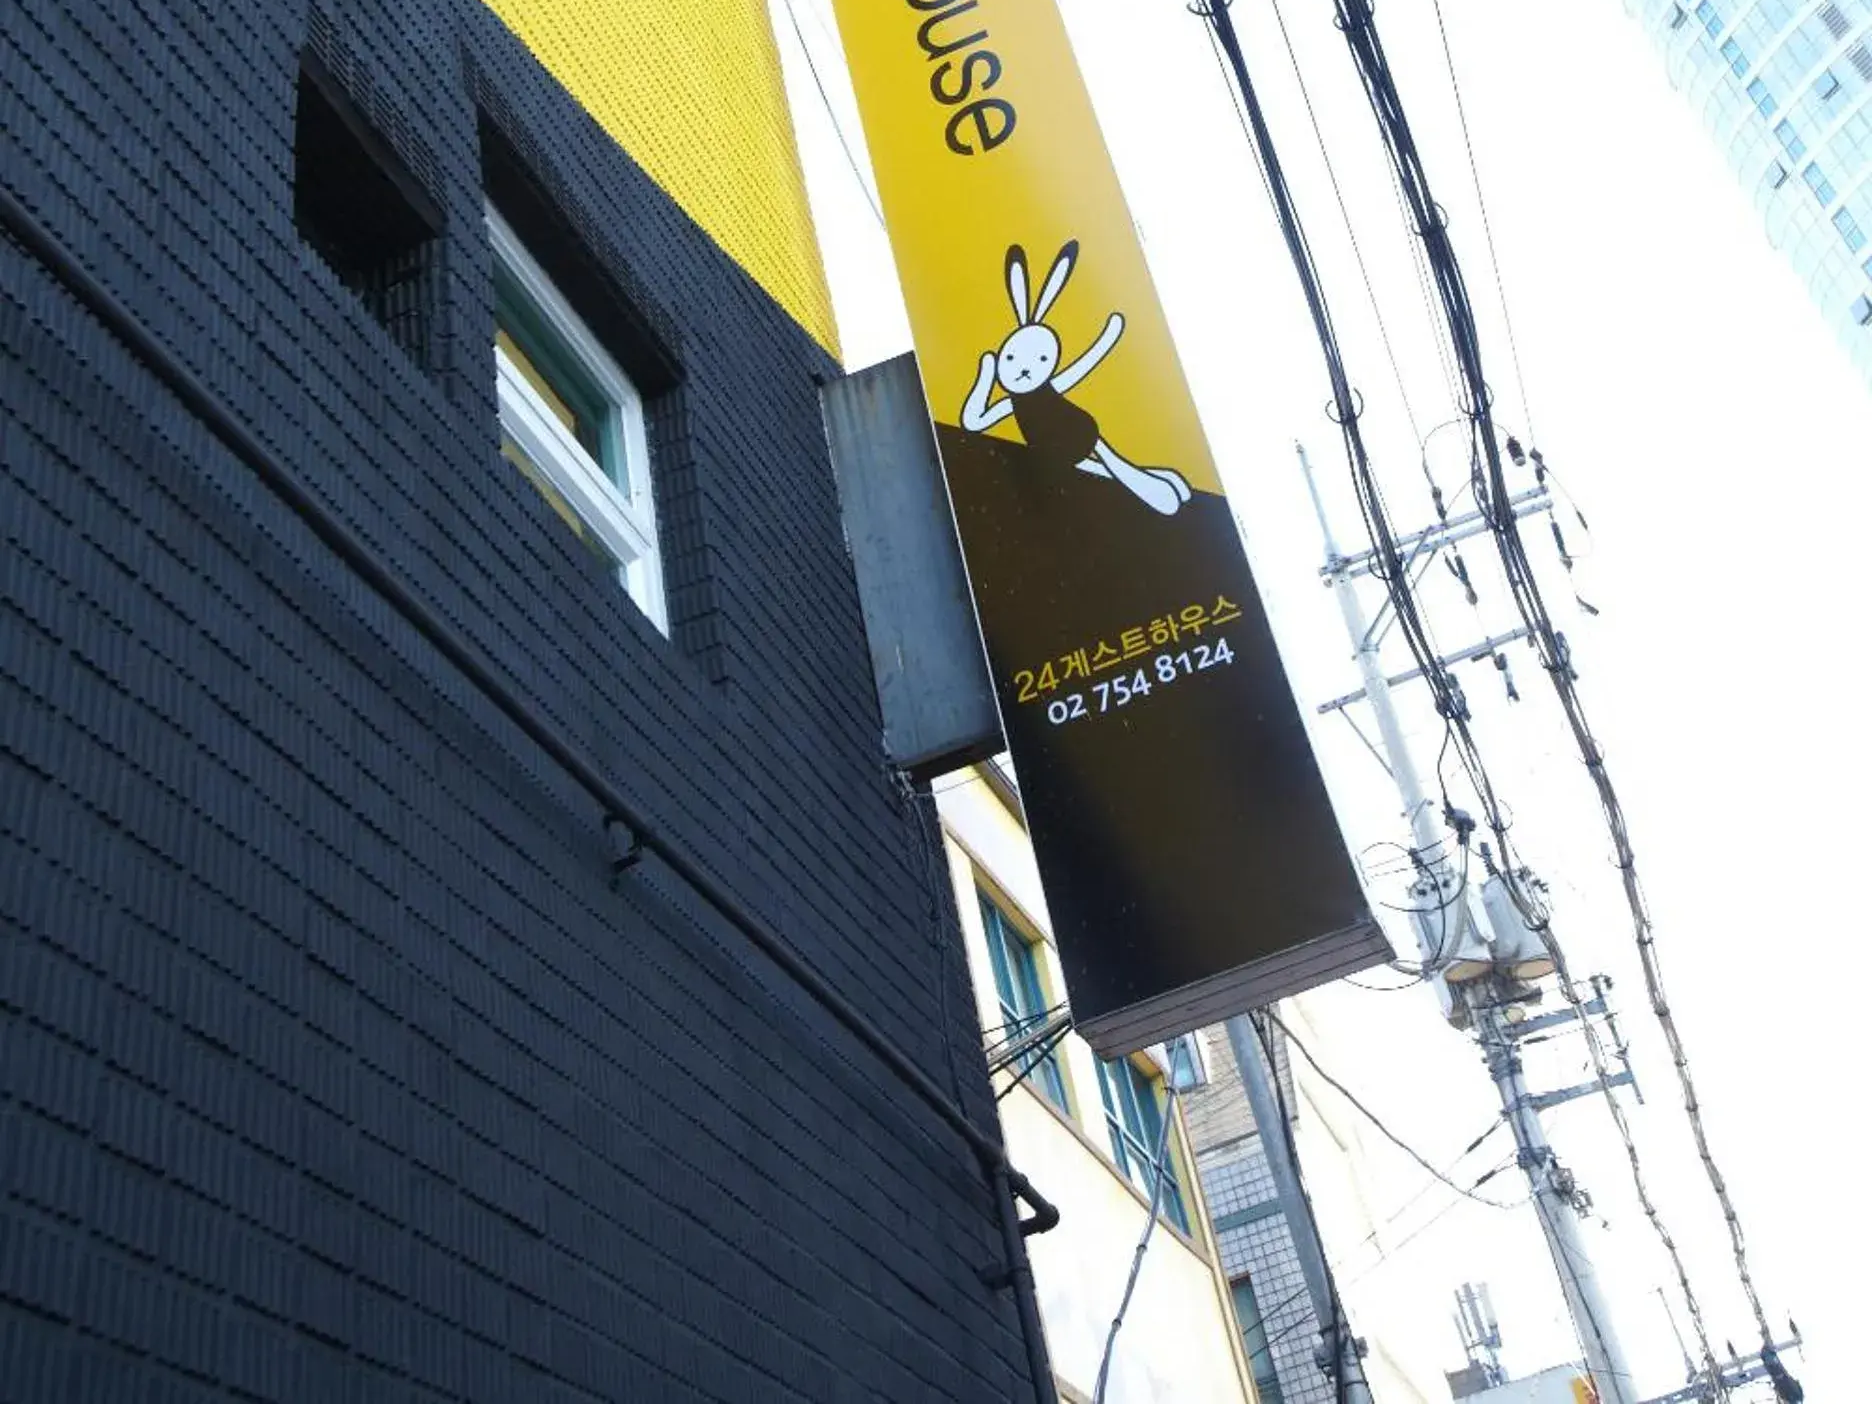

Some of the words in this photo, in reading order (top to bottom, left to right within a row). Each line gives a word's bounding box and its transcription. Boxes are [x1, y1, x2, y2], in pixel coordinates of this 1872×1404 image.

[1047, 694, 1087, 725] 02
[1092, 668, 1152, 712] 754
[1154, 637, 1235, 683] 8124
